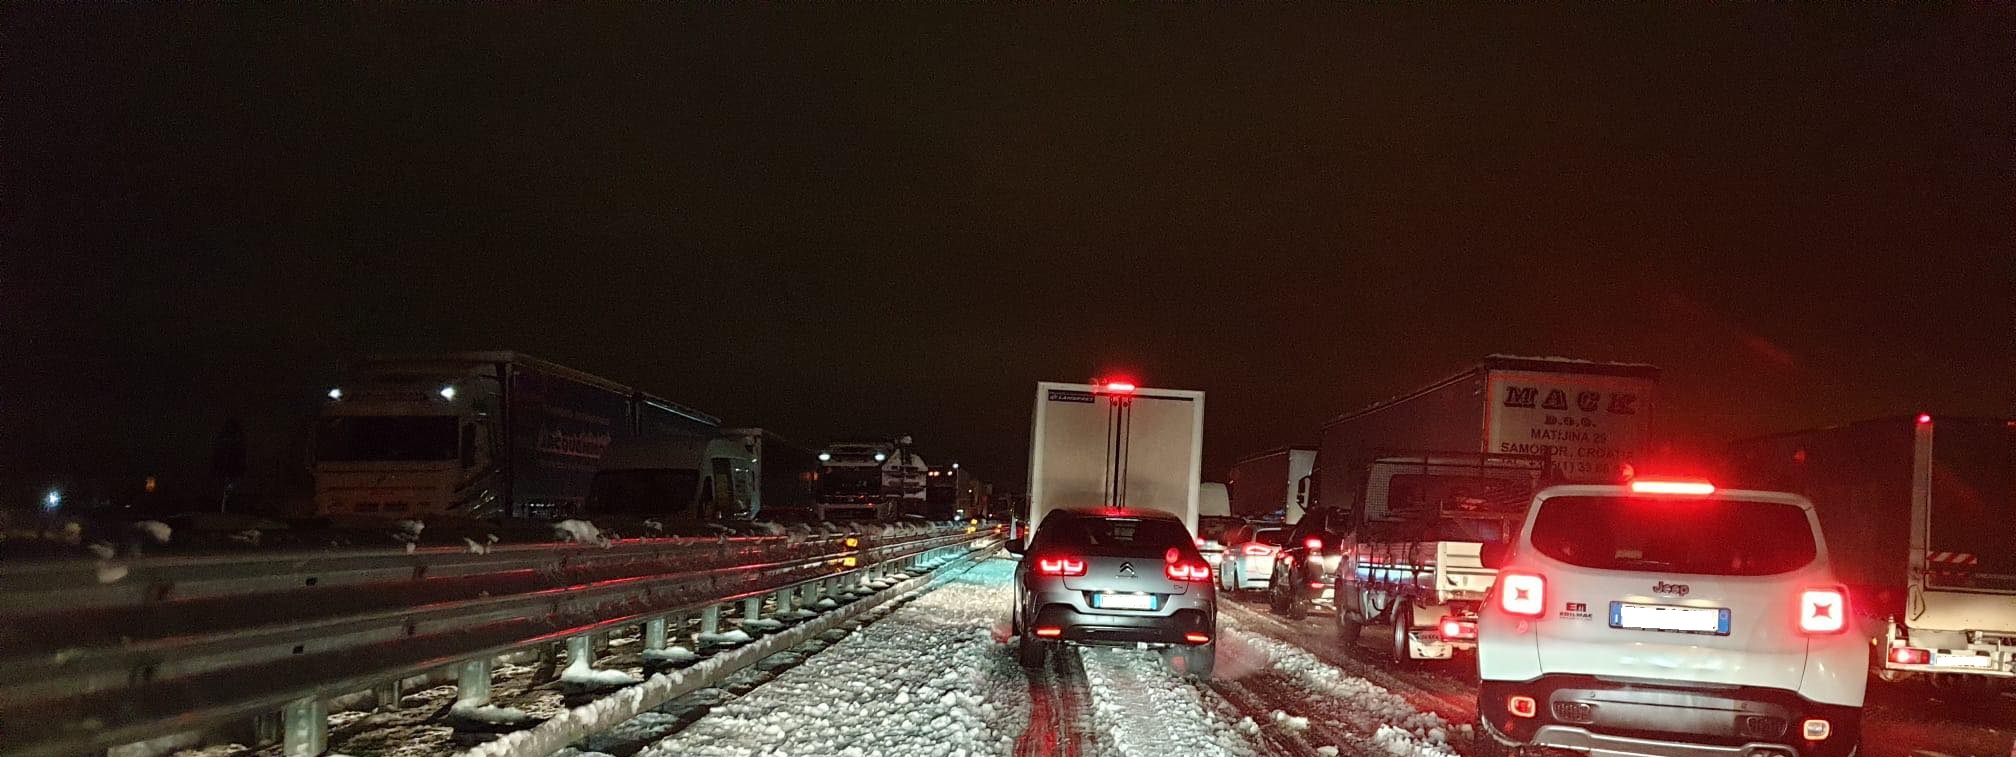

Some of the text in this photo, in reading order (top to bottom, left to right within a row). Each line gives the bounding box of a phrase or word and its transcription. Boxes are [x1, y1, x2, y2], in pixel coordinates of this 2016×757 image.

[1503, 386, 1638, 415] MACK
[1530, 428, 1589, 442] MATIJINA
[1653, 581, 1690, 597] Jeep
